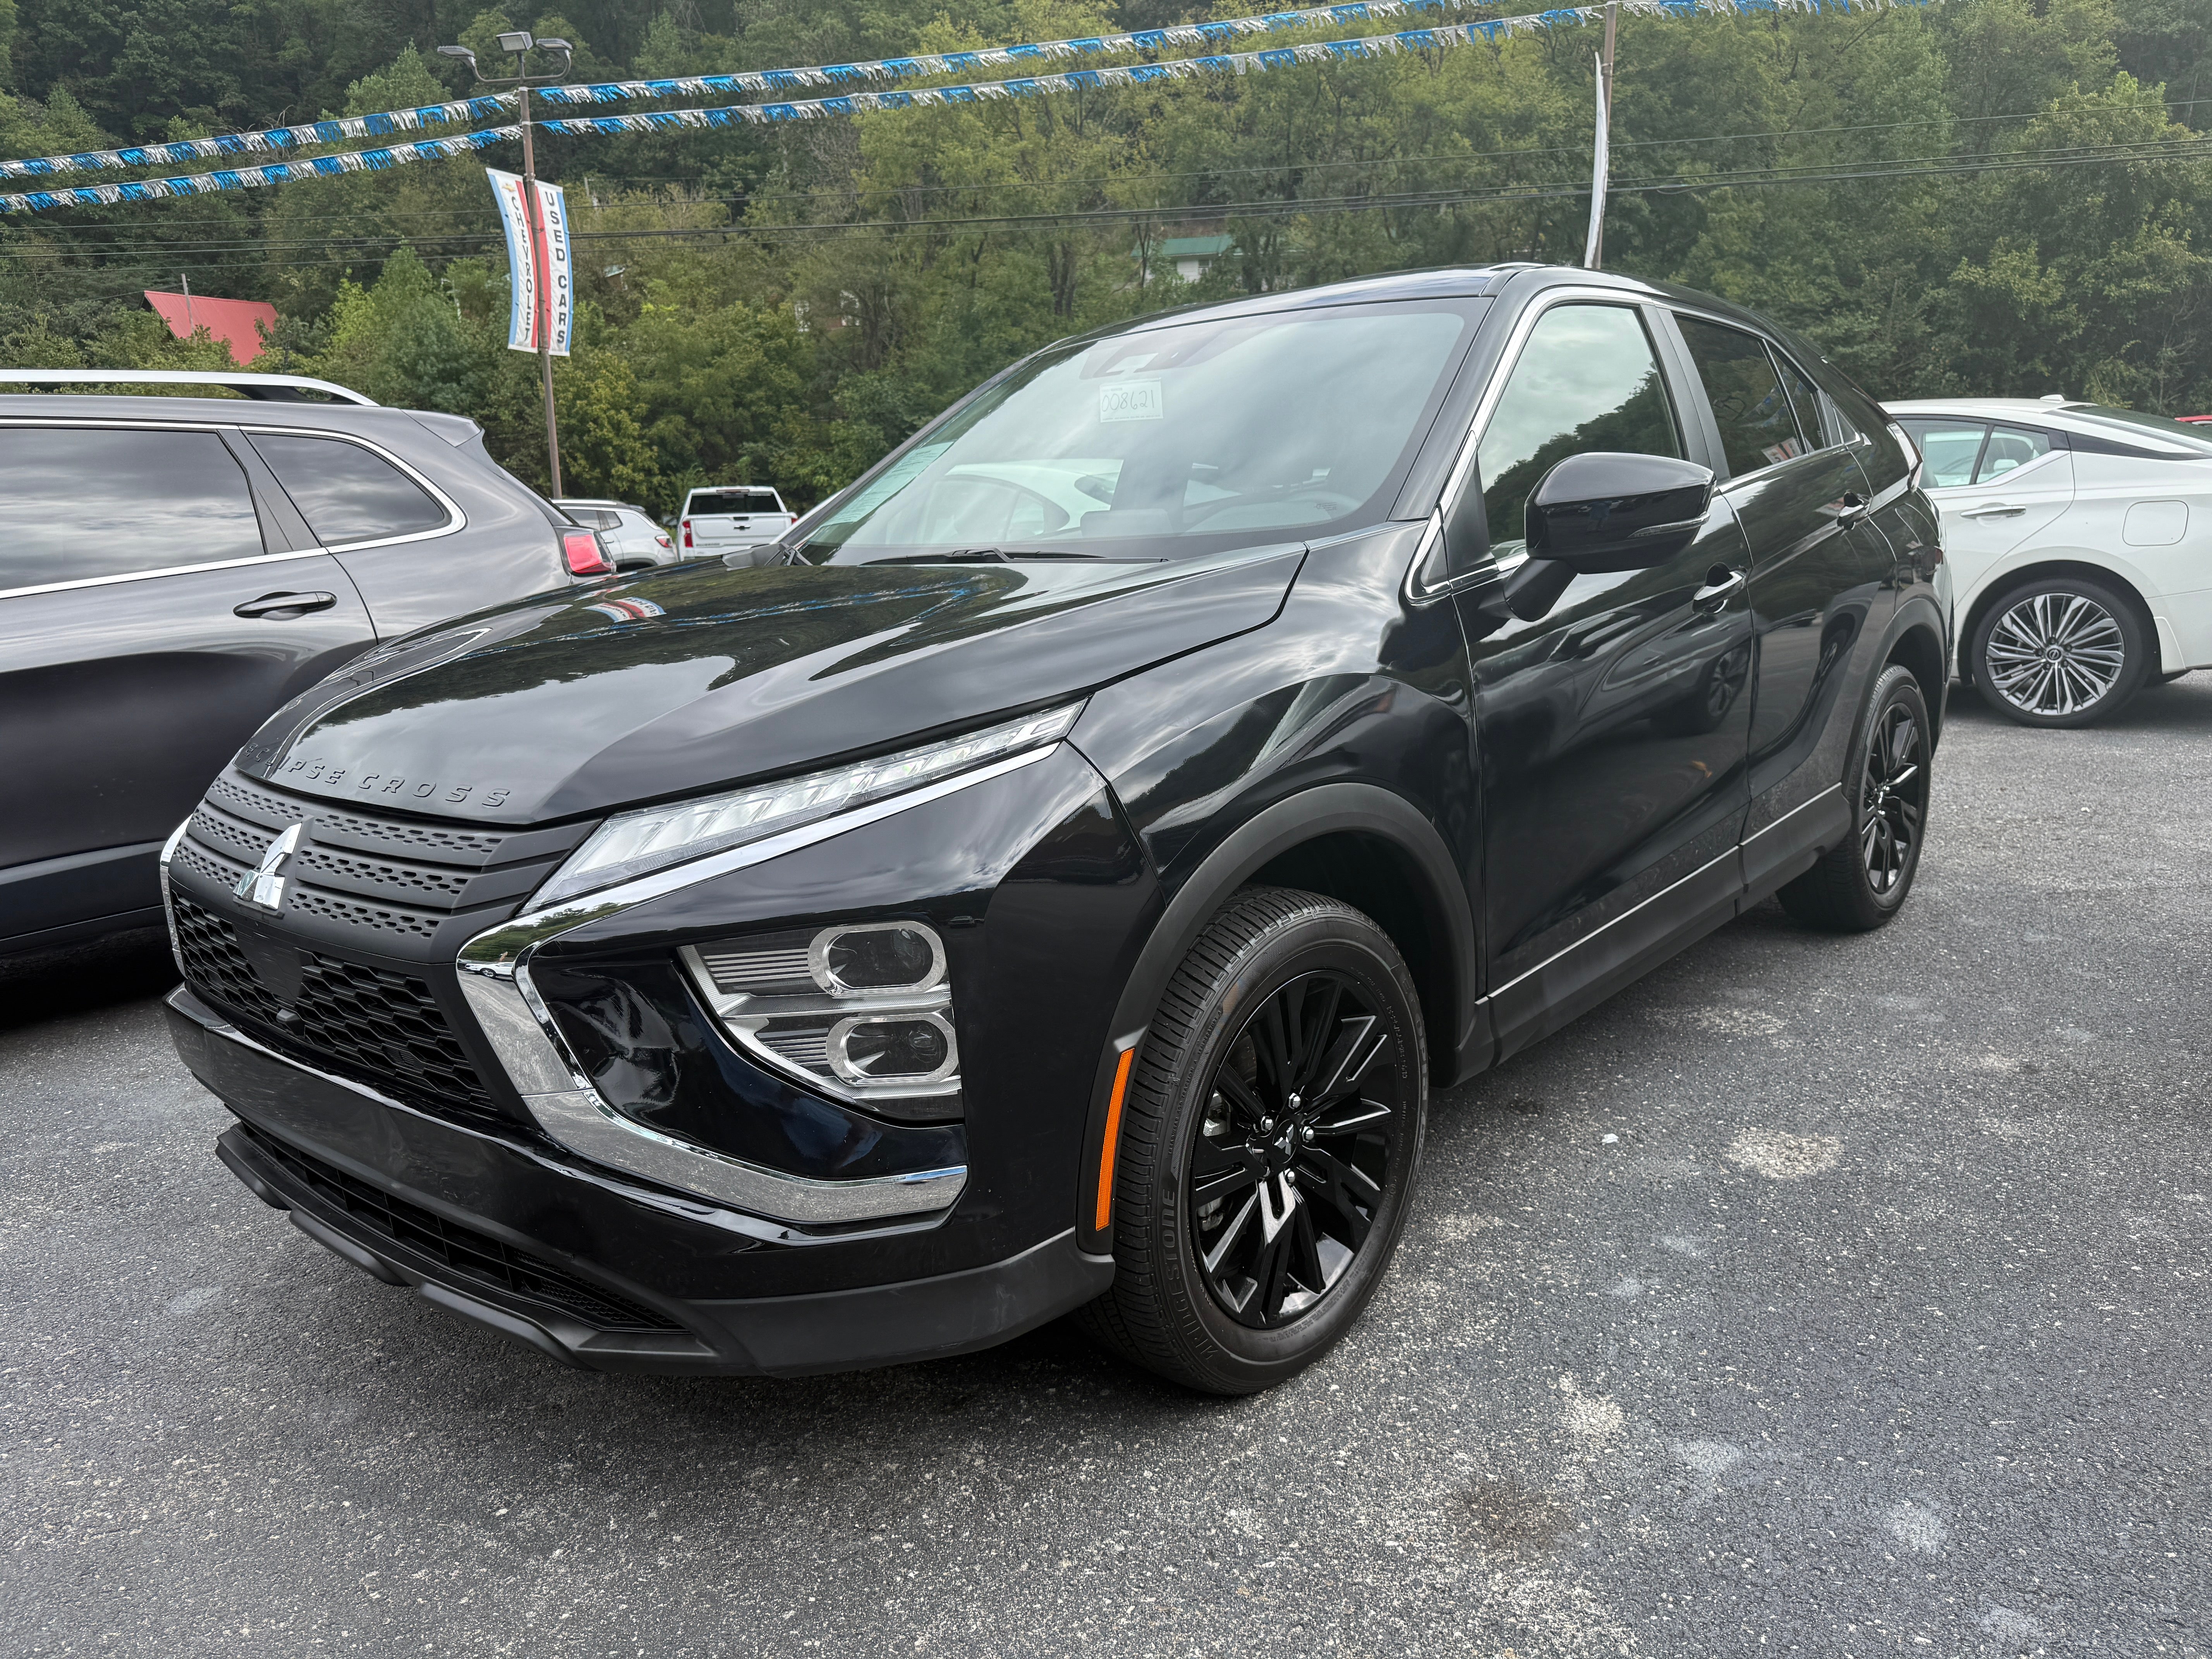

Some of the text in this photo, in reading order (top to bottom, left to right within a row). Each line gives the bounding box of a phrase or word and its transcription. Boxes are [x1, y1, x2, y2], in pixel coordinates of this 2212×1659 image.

[511, 196, 533, 342] CHEVROLET
[545, 192, 567, 344] USED CARS
[1101, 390, 1154, 412] 008621
[243, 743, 510, 808] ECLIPSE CROSS
